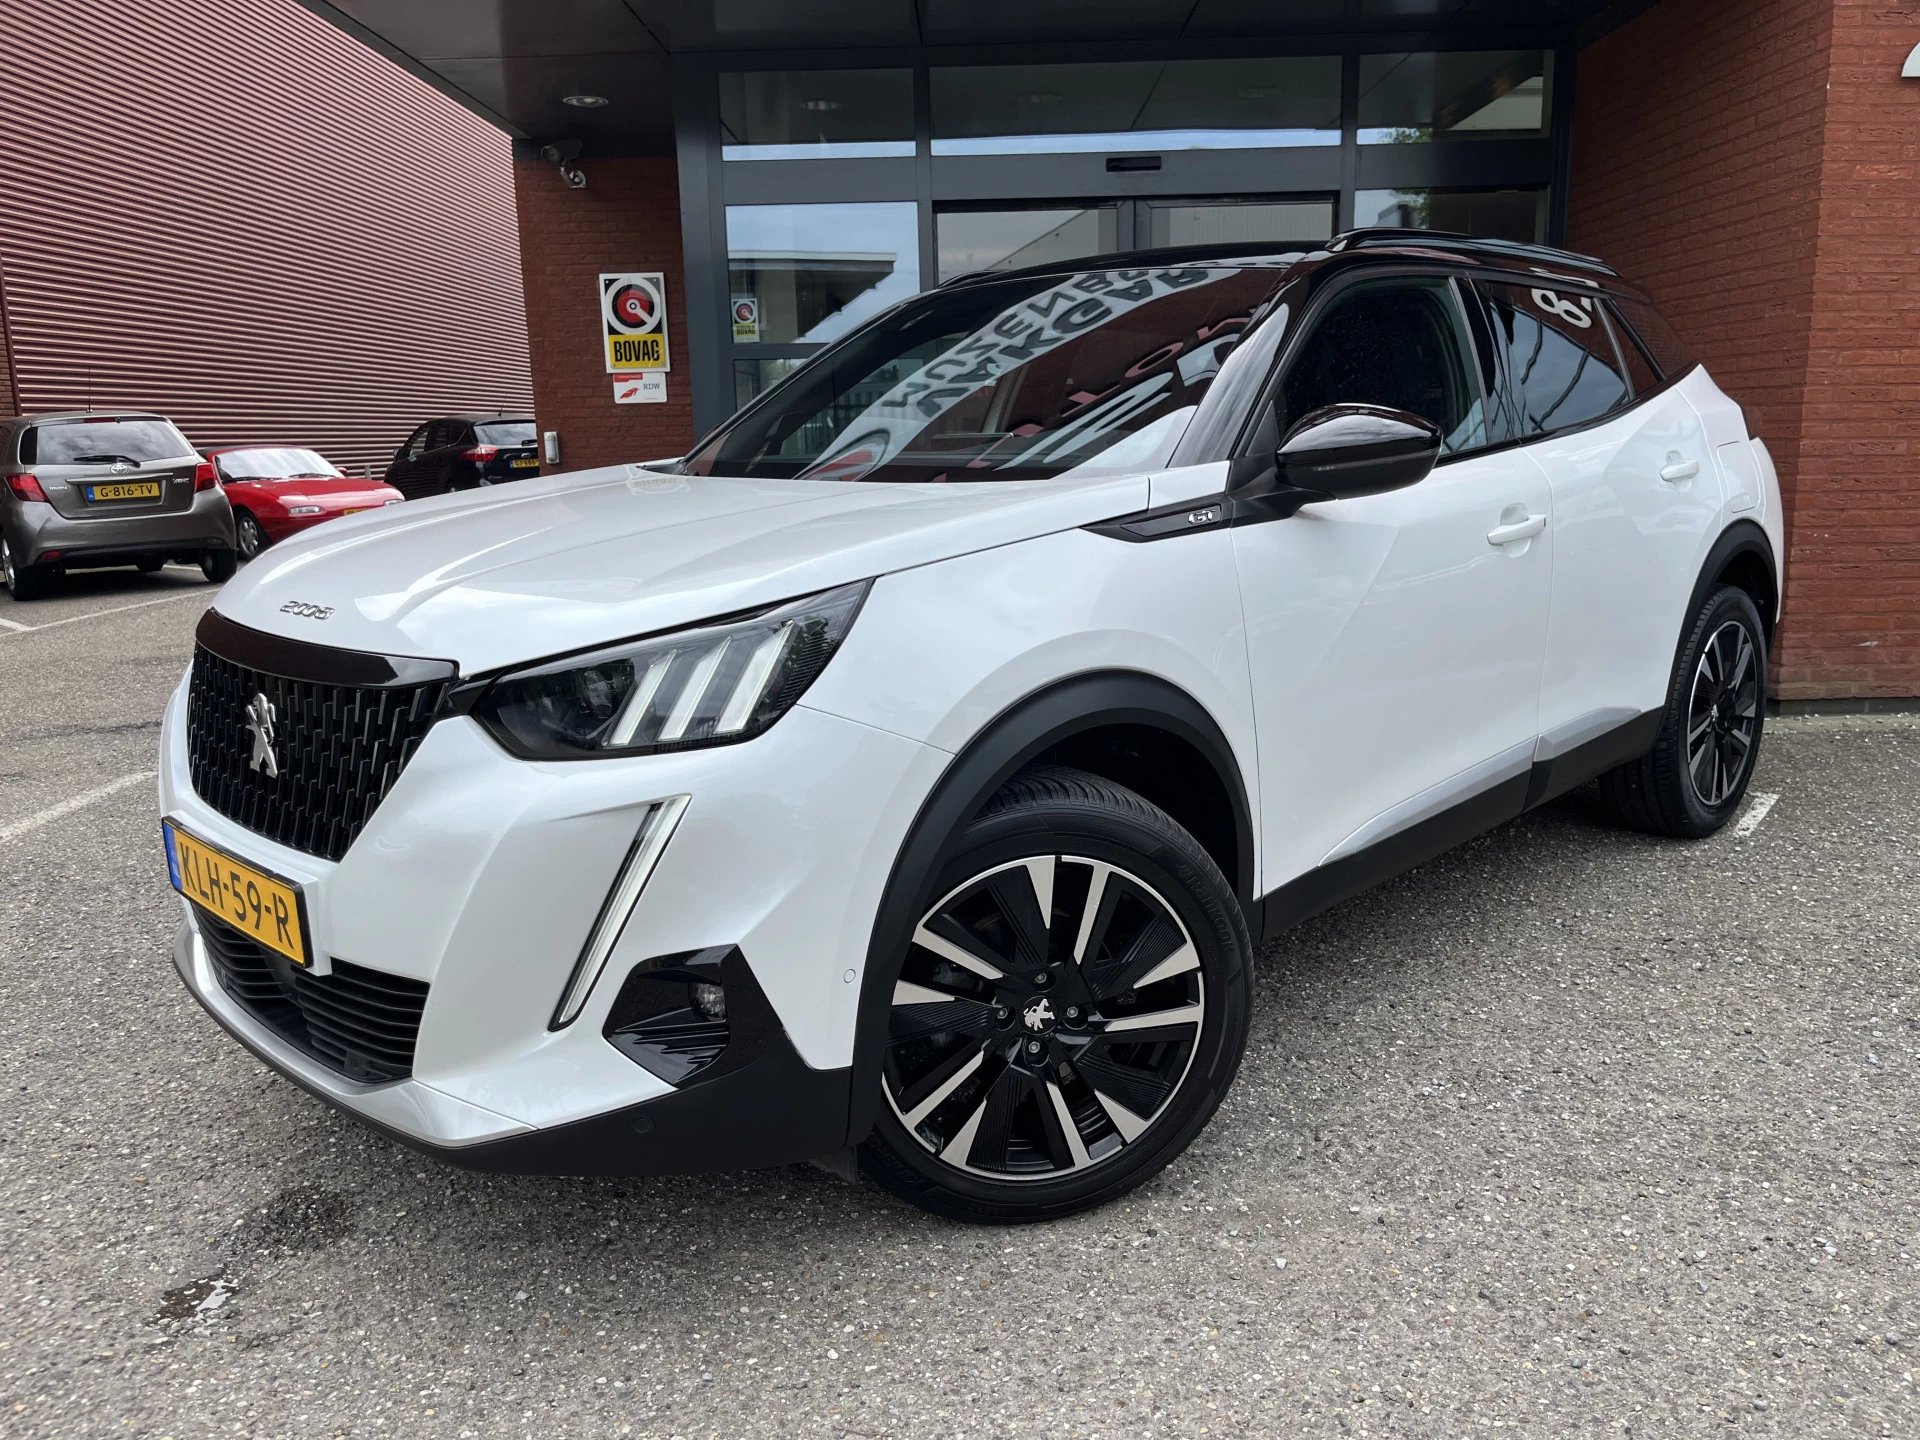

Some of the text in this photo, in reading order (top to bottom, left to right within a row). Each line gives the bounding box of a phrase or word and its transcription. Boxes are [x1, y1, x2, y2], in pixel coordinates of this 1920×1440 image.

[613, 340, 661, 362] BOVAG
[100, 485, 153, 497] G-816-TV
[280, 601, 335, 620] 2008
[180, 842, 295, 949] KLH-59-R
